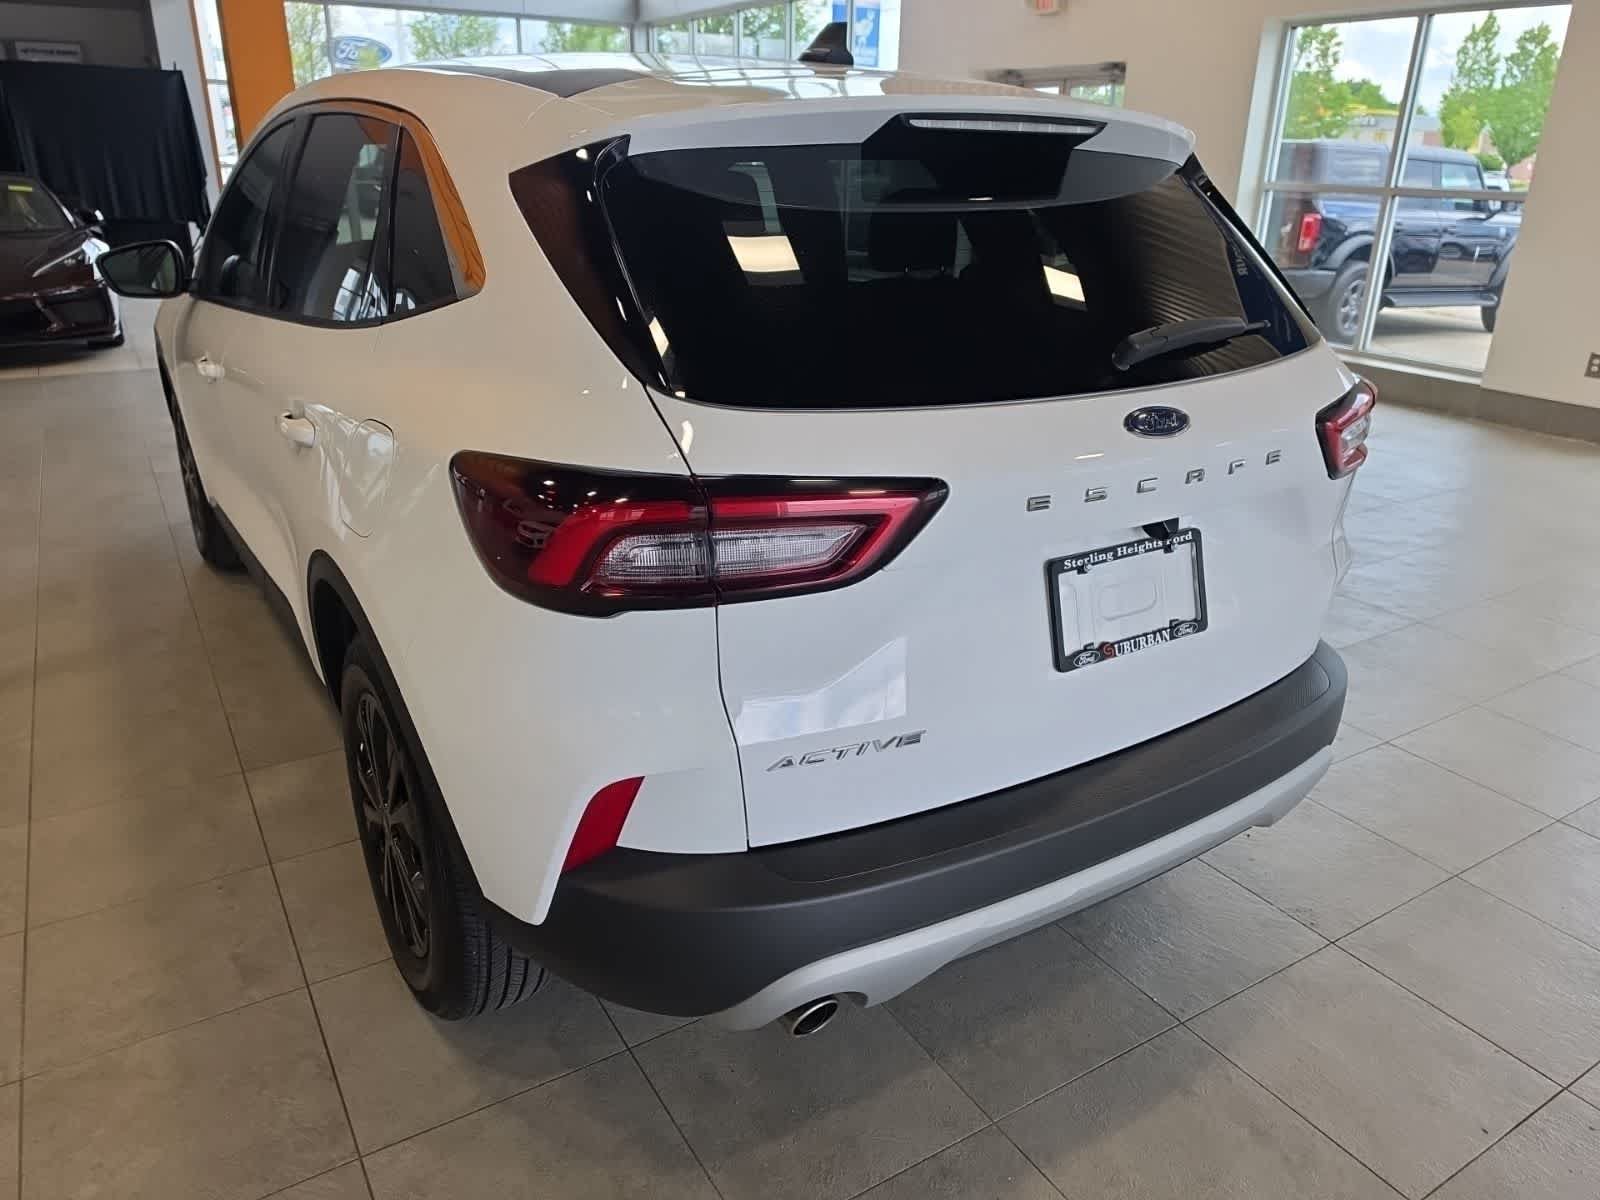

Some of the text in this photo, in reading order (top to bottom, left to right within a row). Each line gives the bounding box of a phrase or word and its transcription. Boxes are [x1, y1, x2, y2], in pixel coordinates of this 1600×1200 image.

[1026, 449, 1282, 512] ESCAPE
[1063, 550, 1114, 570] Sterling
[1116, 539, 1163, 557] Heights
[1076, 651, 1097, 665] Ford
[1176, 622, 1195, 636] Ford
[765, 729, 927, 772] ACTIVE
